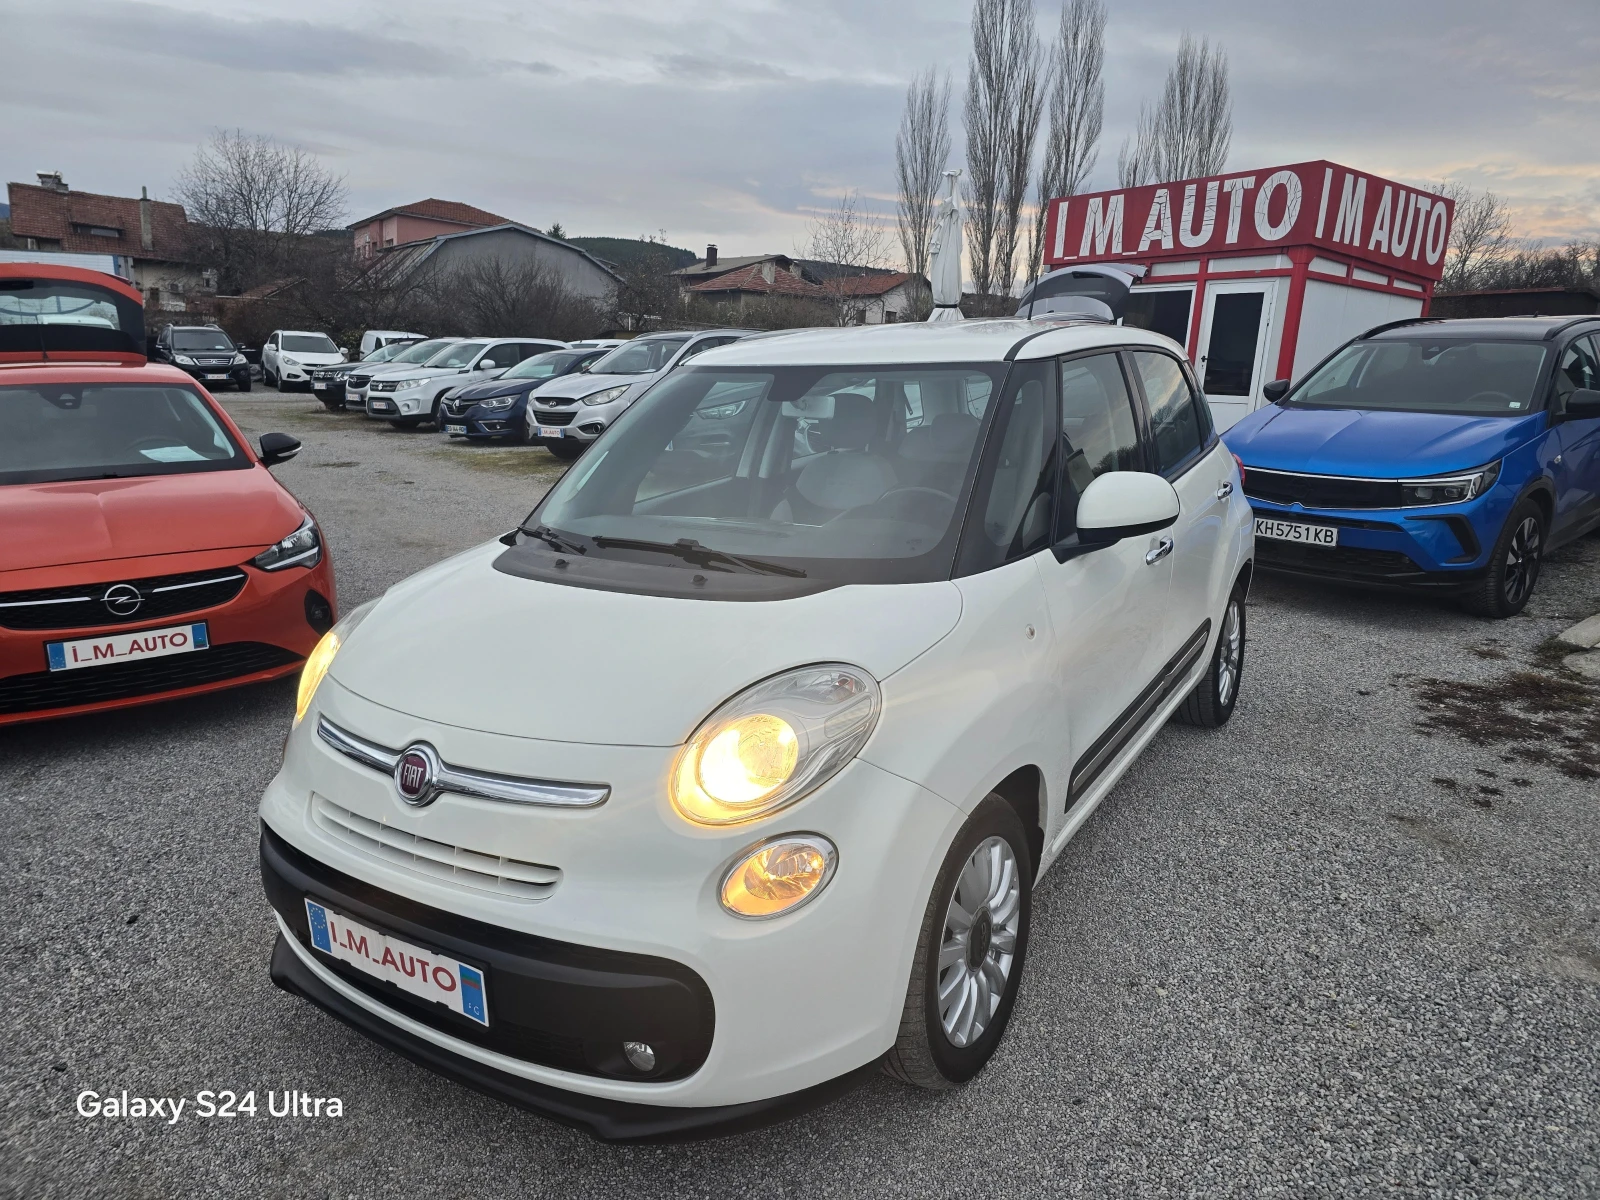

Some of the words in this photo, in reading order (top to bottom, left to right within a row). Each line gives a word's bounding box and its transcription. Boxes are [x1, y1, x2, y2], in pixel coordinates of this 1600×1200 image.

[1315, 167, 1333, 239] I
[1332, 173, 1367, 247] M
[1367, 185, 1447, 266] AUTO
[402, 763, 424, 789] FIAT
[330, 921, 457, 992] I_M_AUTO
